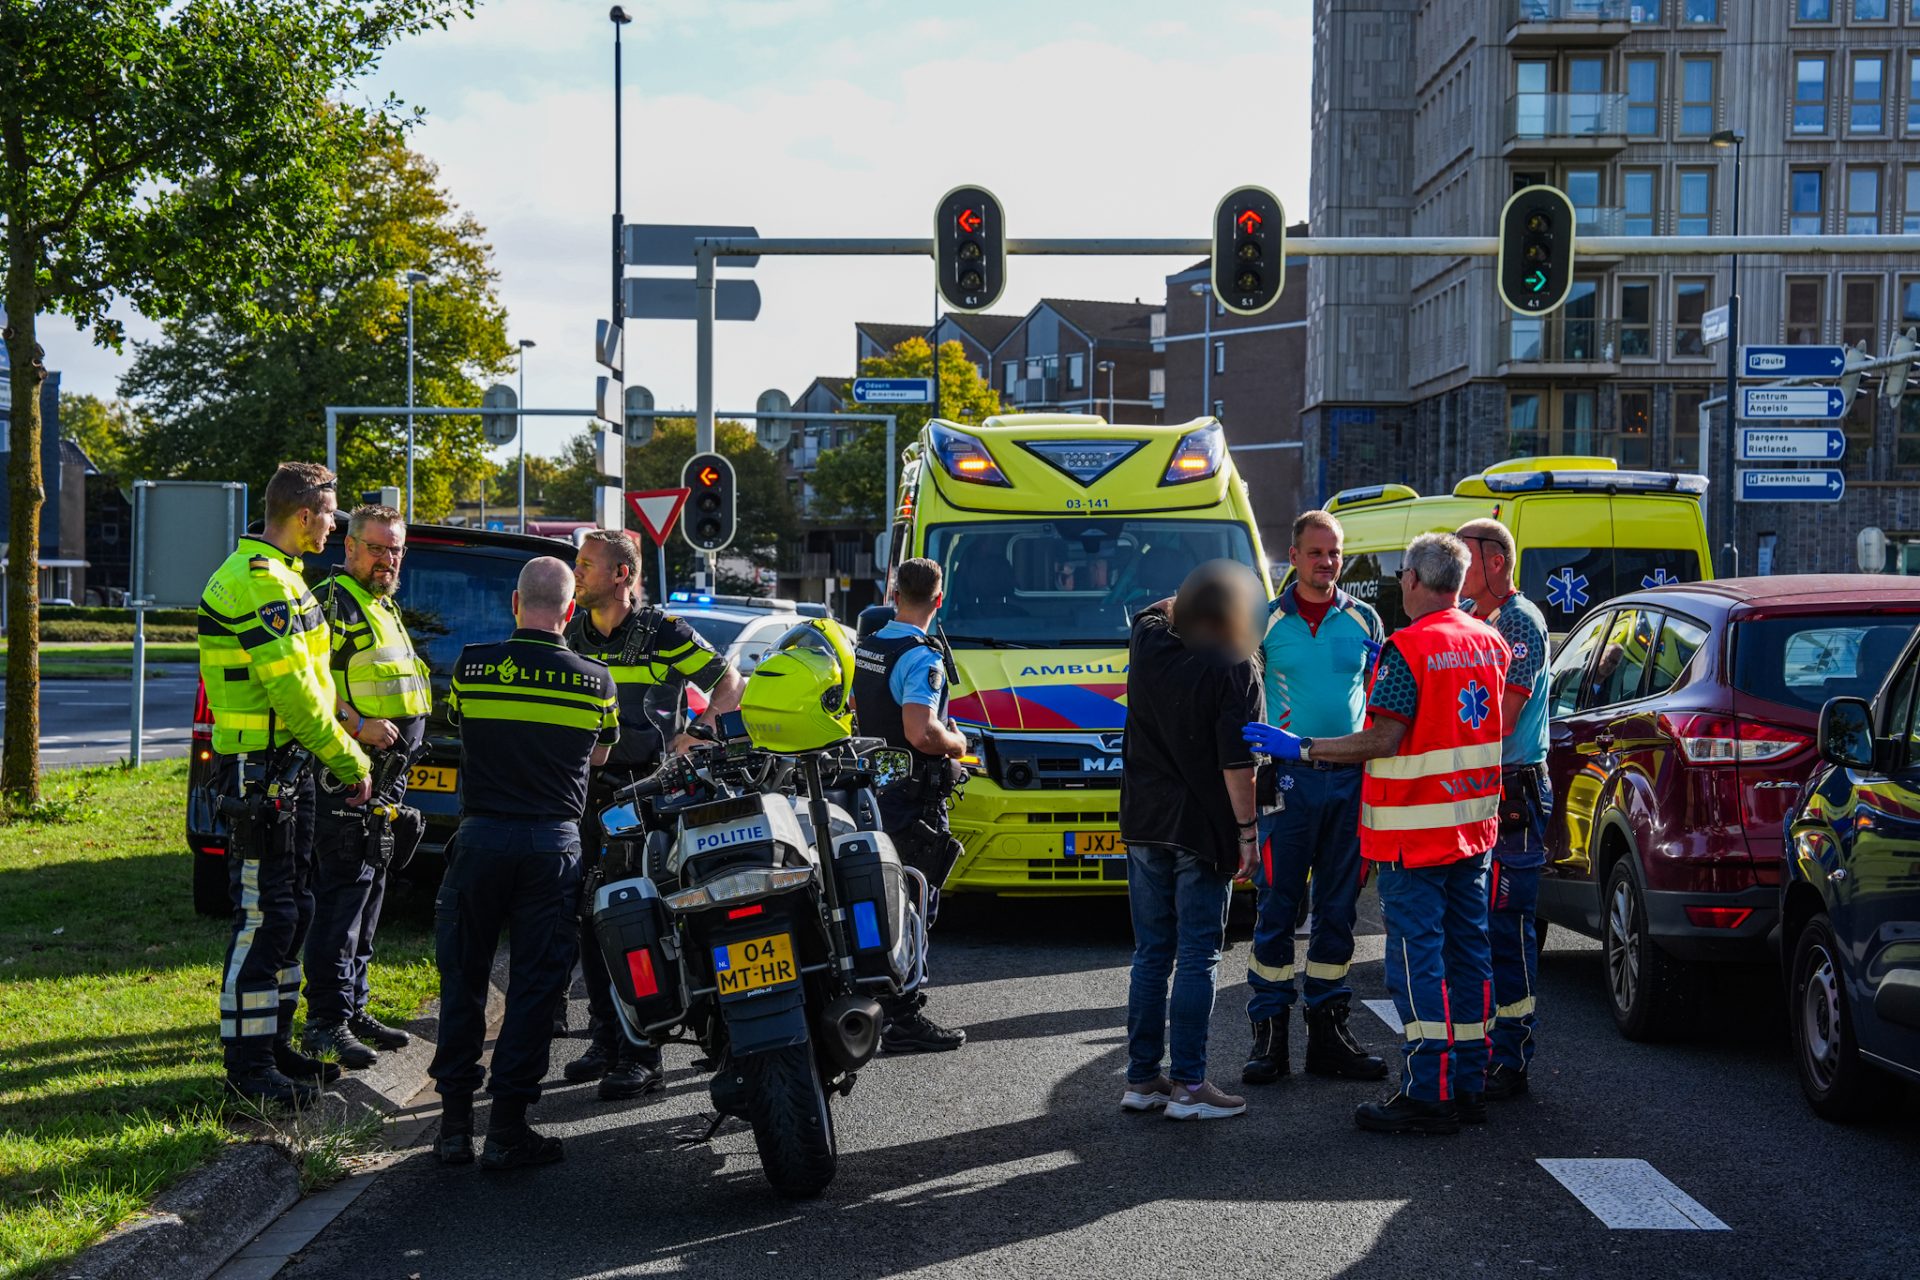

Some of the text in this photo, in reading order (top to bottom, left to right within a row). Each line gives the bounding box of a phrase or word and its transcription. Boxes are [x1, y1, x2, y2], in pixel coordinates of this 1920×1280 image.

[1241, 297, 1254, 306] 5.1
[1527, 299, 1540, 307] 4.1
[1761, 357, 1784, 365] route
[1749, 392, 1788, 400] Centrum
[1749, 404, 1788, 413] Angelslo
[1749, 433, 1789, 443] Bargeres
[1748, 445, 1797, 453] Rietlanden
[1760, 474, 1811, 483] Ziekenhuis
[1066, 499, 1109, 509] 03-141
[1427, 650, 1504, 672] AMBULANCE
[484, 657, 582, 686] POLITIE
[1020, 664, 1130, 676] AMBULA
[1083, 757, 1124, 771] MA
[405, 769, 448, 788] 29-L
[697, 826, 763, 850] POLITIE
[1083, 835, 1122, 851] JXJ-
[744, 939, 775, 962] 04
[719, 960, 792, 992] MT-HR
[747, 986, 772, 998] politie.nl
